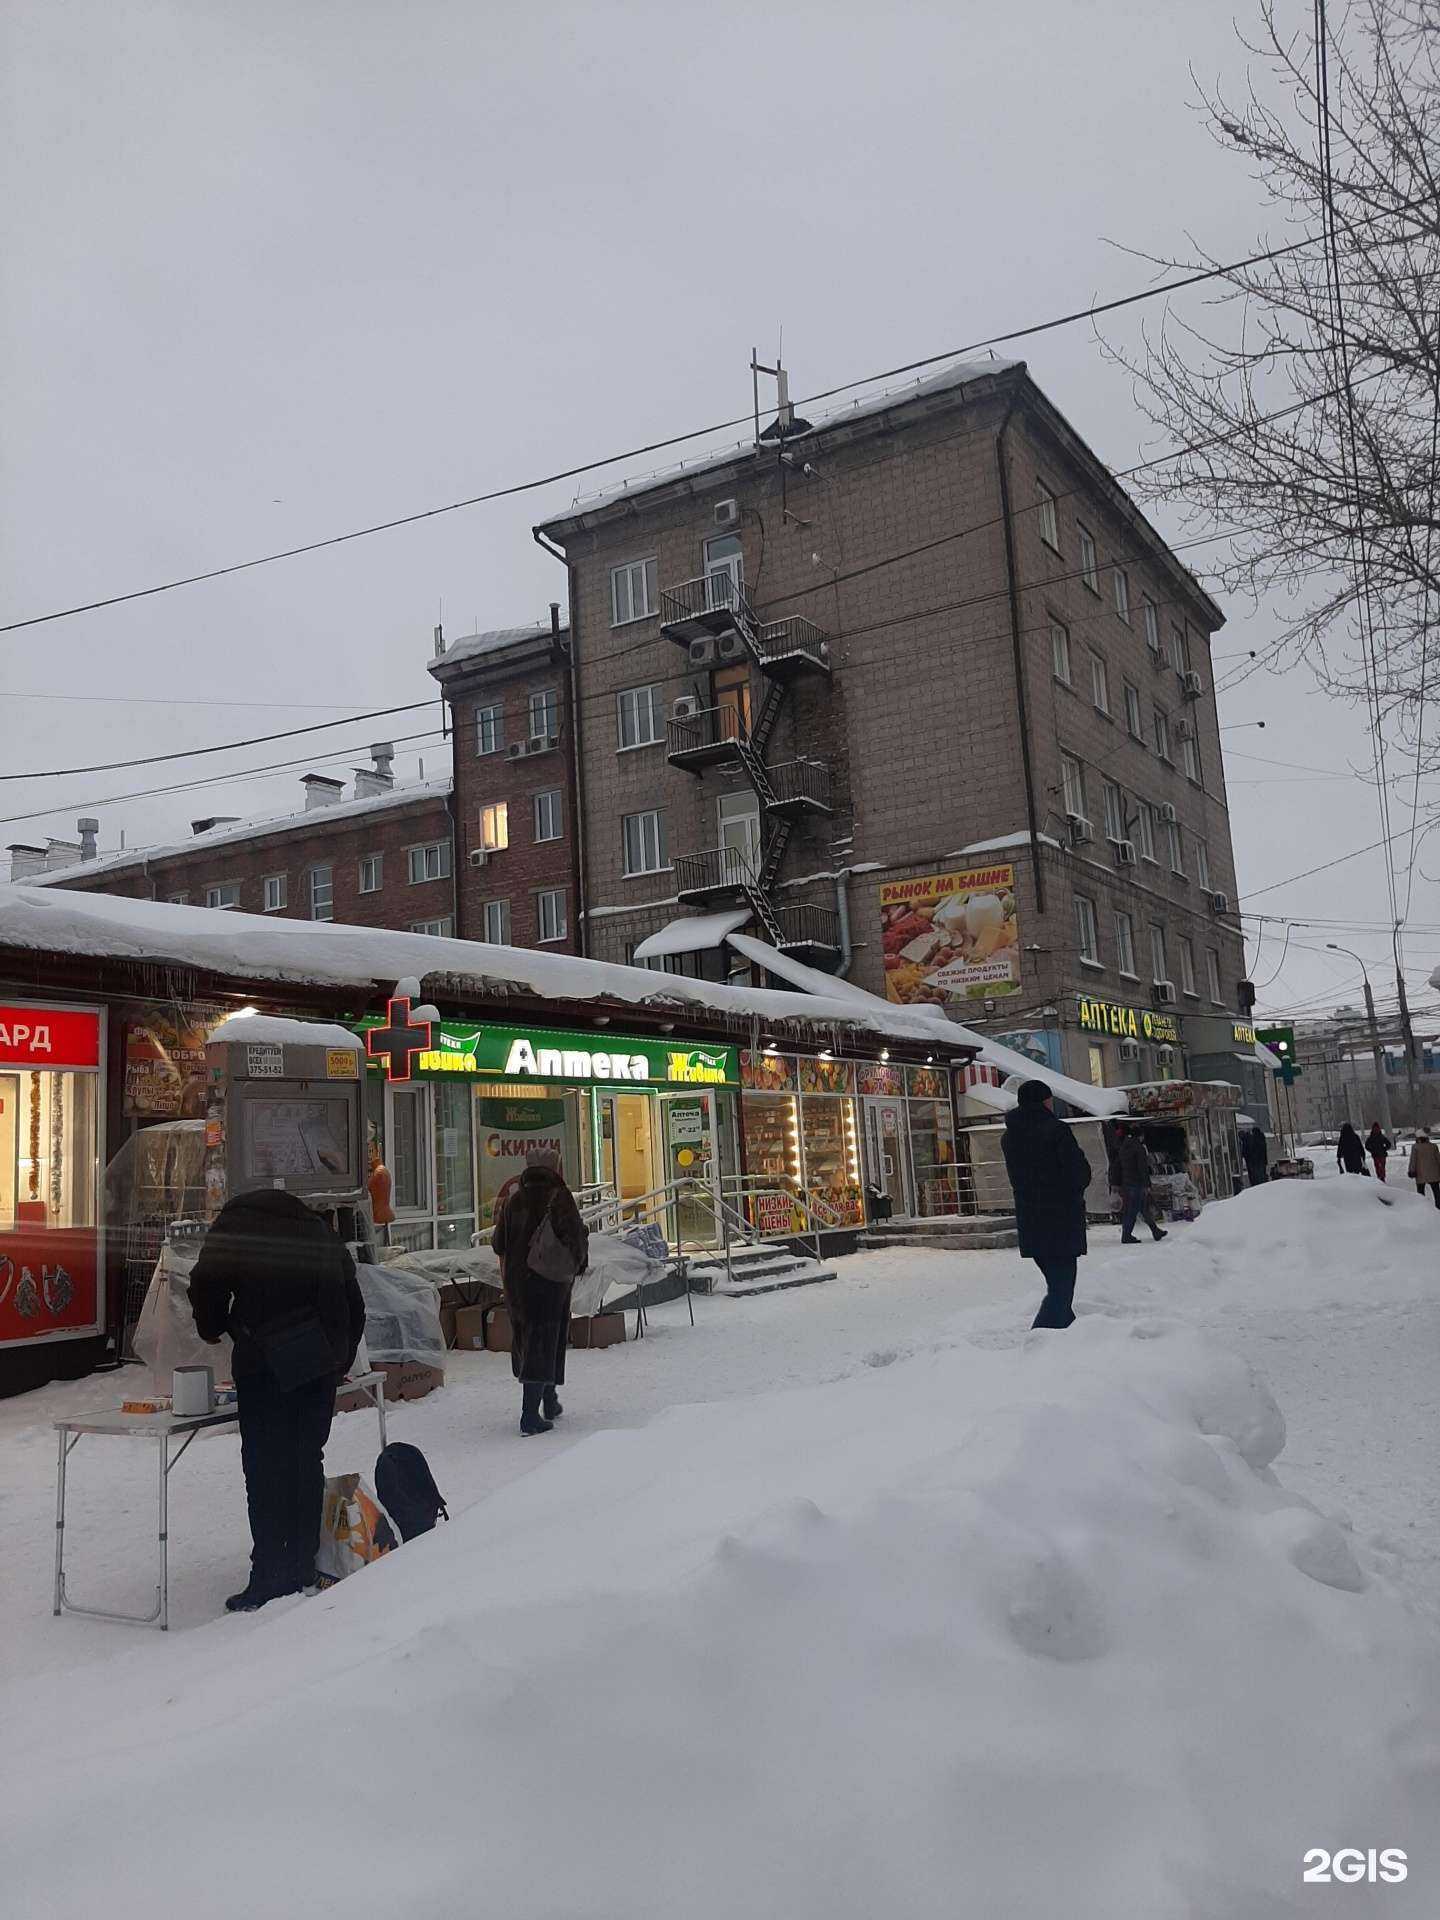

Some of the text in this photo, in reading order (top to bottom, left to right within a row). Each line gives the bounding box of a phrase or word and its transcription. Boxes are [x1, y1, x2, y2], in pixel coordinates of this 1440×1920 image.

[882, 869, 1010, 901] РЫНОК НА БАШНЕ
[937, 963, 1009, 978] СВЕЖИЕ ПРОДУКТЫ
[950, 976, 980, 985] НИЗКИМ
[983, 973, 1009, 981] ЦЕНАМ
[1081, 1001, 1137, 1036] АПТЕКА
[504, 1039, 649, 1080] Аптека
